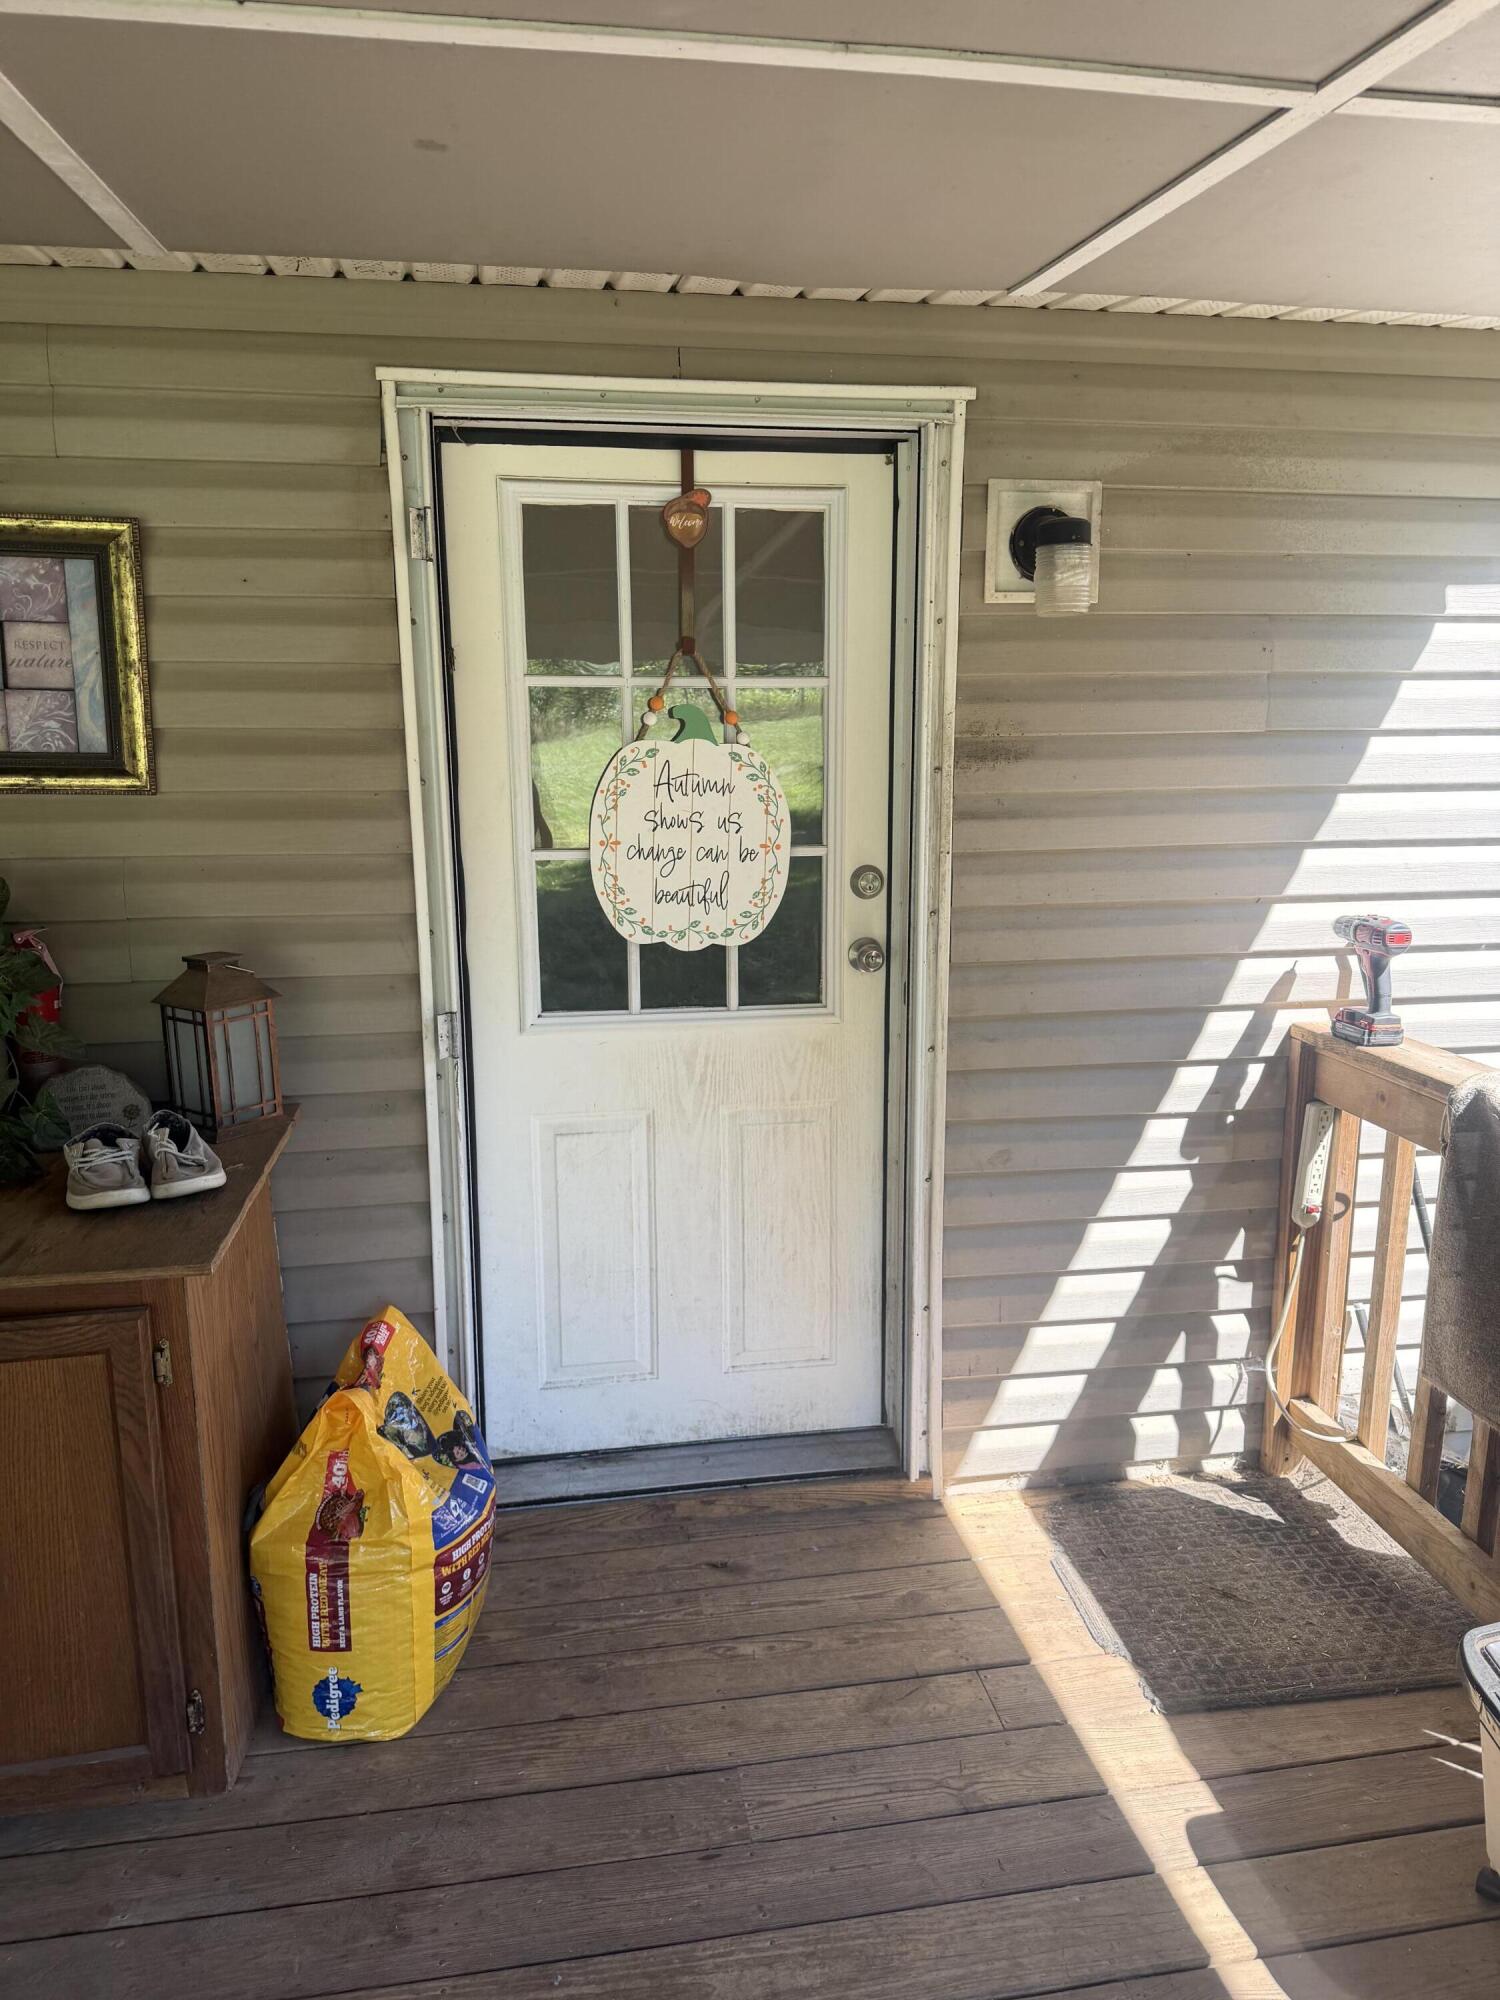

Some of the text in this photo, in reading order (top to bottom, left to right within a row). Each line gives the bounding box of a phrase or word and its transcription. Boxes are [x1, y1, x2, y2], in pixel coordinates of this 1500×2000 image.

[14, 640, 65, 650] RESPECT
[653, 759, 735, 803] Autumn
[626, 833, 760, 878] change can be
[654, 870, 730, 915] beautiful
[441, 1554, 468, 1577] WITH
[452, 1539, 472, 1562] HIGH
[319, 1596, 329, 1616] RED
[336, 1579, 344, 1606] FLAVOR
[309, 1573, 321, 1649] HIGH PROTEIN
[320, 1618, 330, 1649] WITH
[326, 1666, 342, 1729] Pedigree
